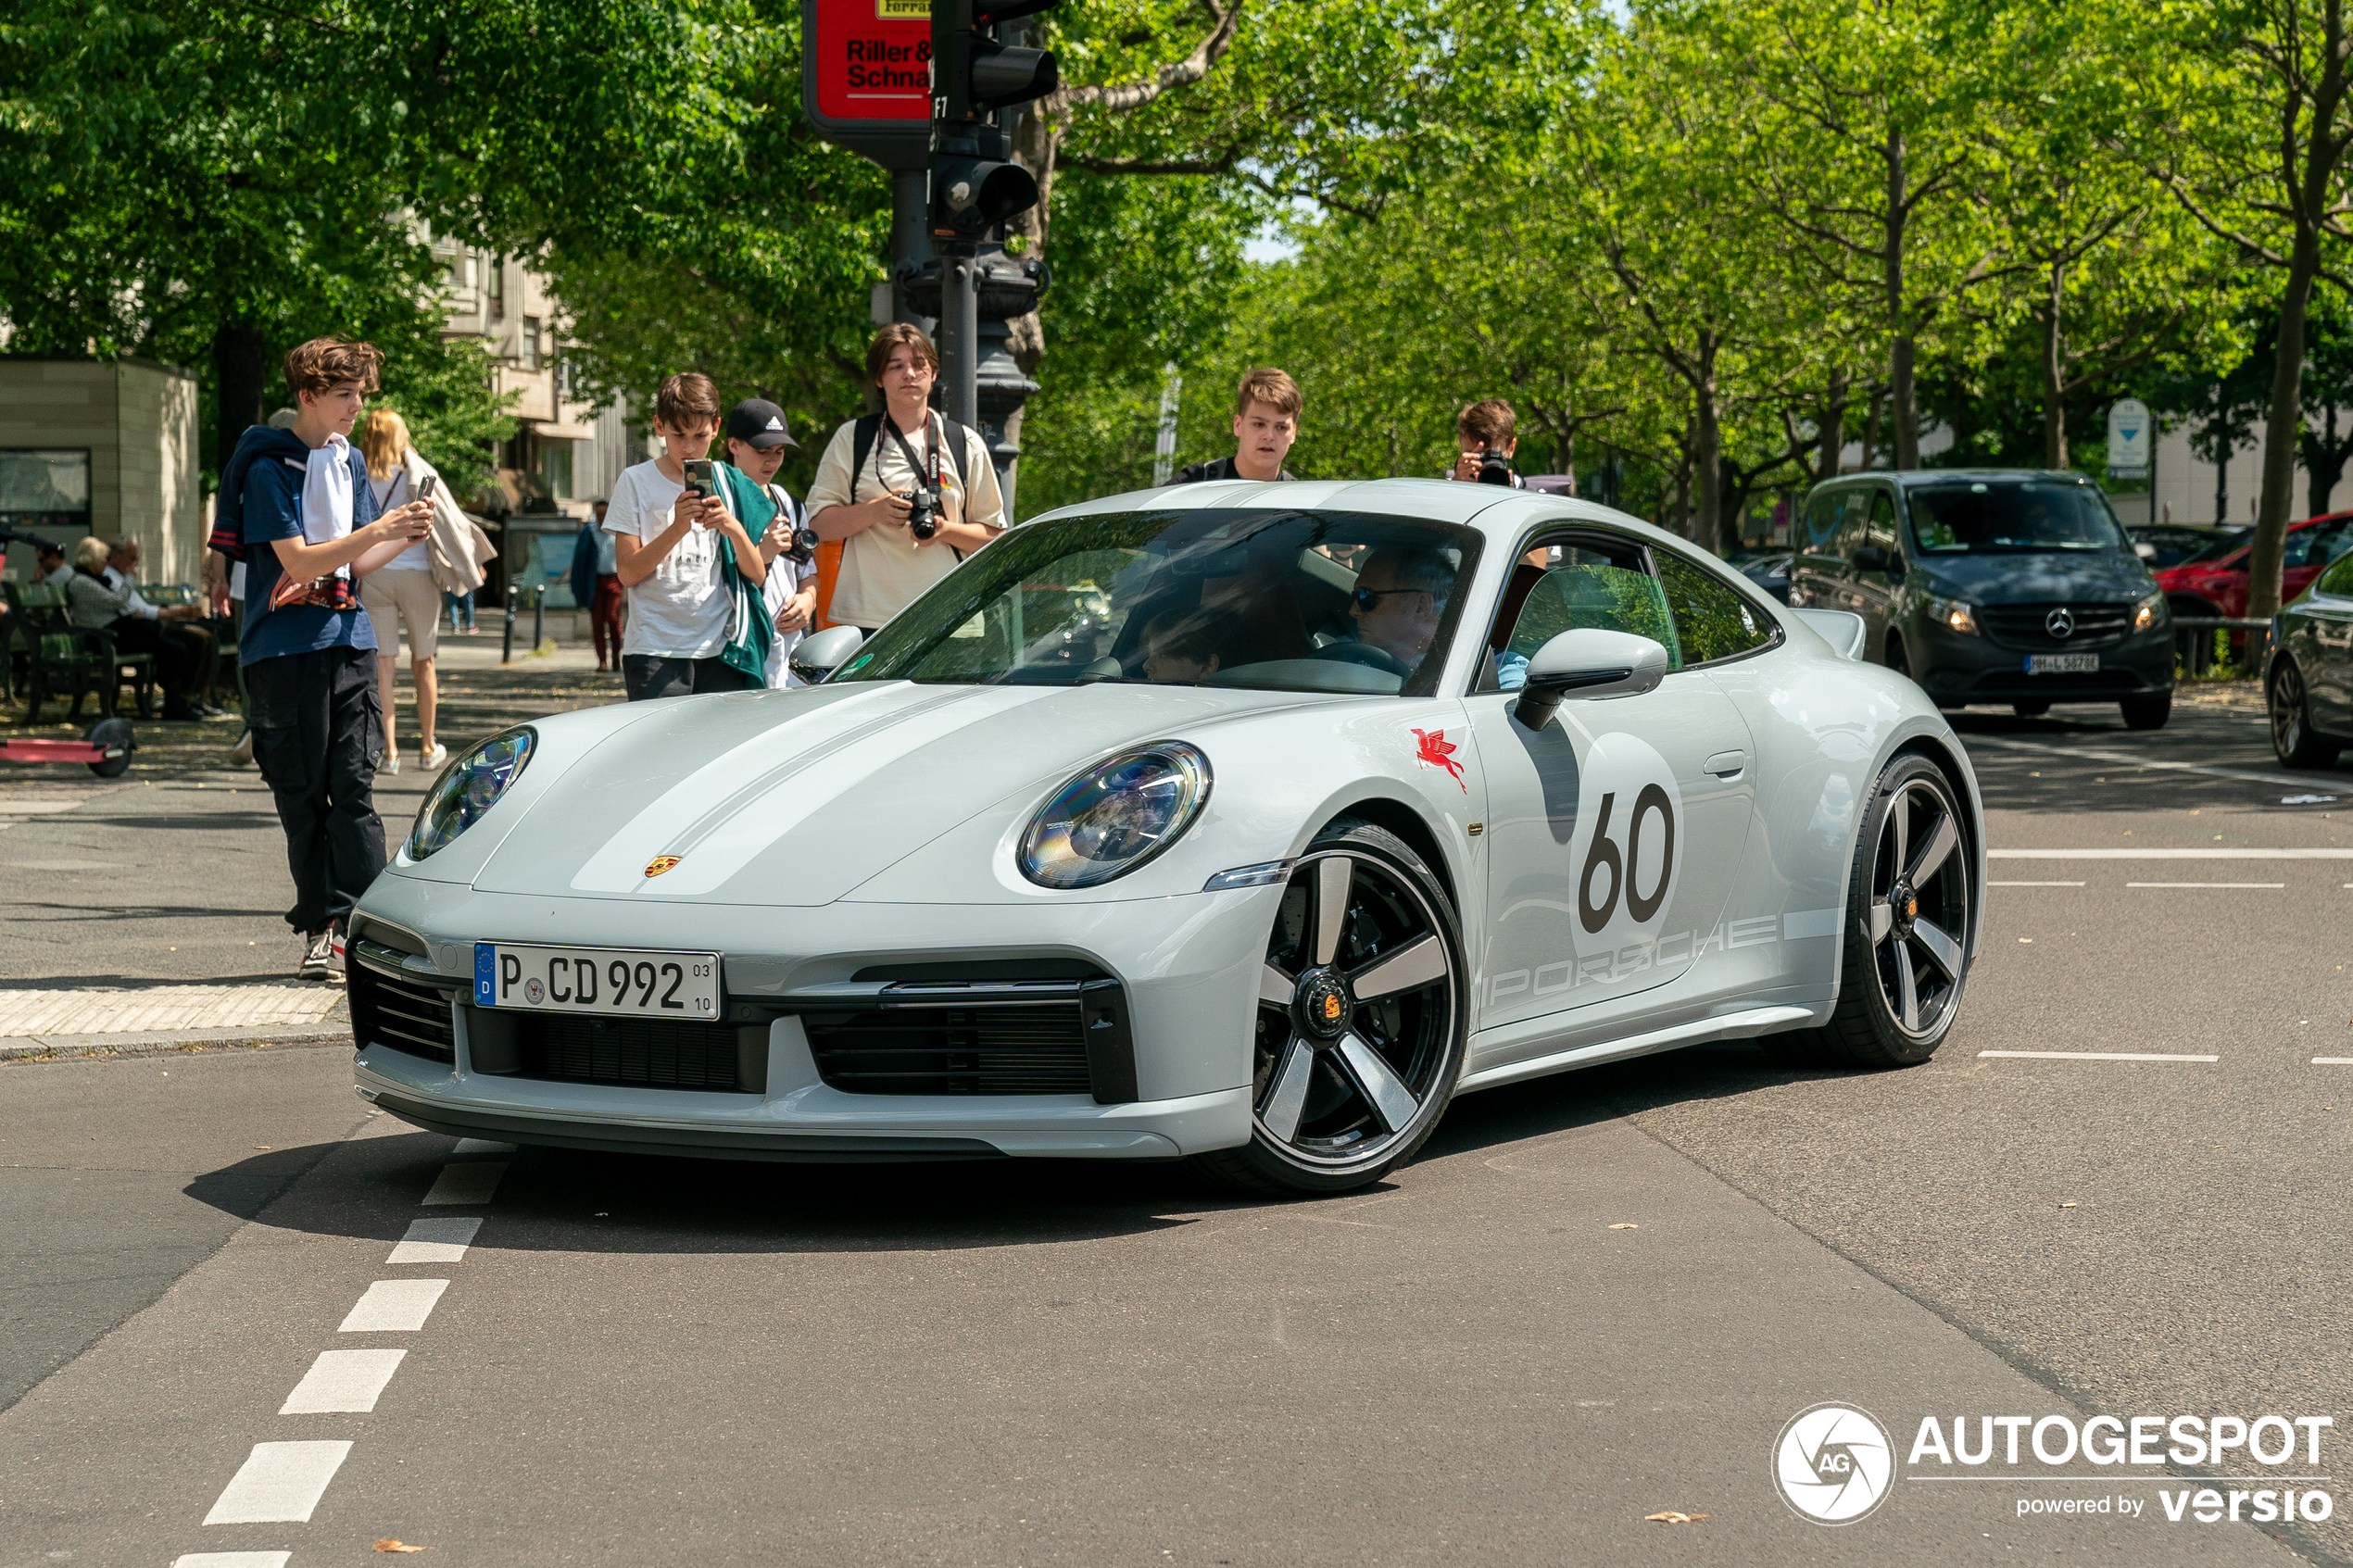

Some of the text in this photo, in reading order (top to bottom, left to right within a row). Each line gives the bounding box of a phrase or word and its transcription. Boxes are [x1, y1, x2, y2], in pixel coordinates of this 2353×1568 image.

[935, 96, 947, 119] F7
[1578, 783, 1675, 934] 60
[693, 964, 711, 977] 03
[1491, 914, 1778, 1006] PORSCHE
[482, 981, 490, 995] D
[500, 953, 522, 999] P
[549, 957, 598, 1005] CD
[608, 960, 685, 1010] 992
[695, 997, 711, 1011] 10
